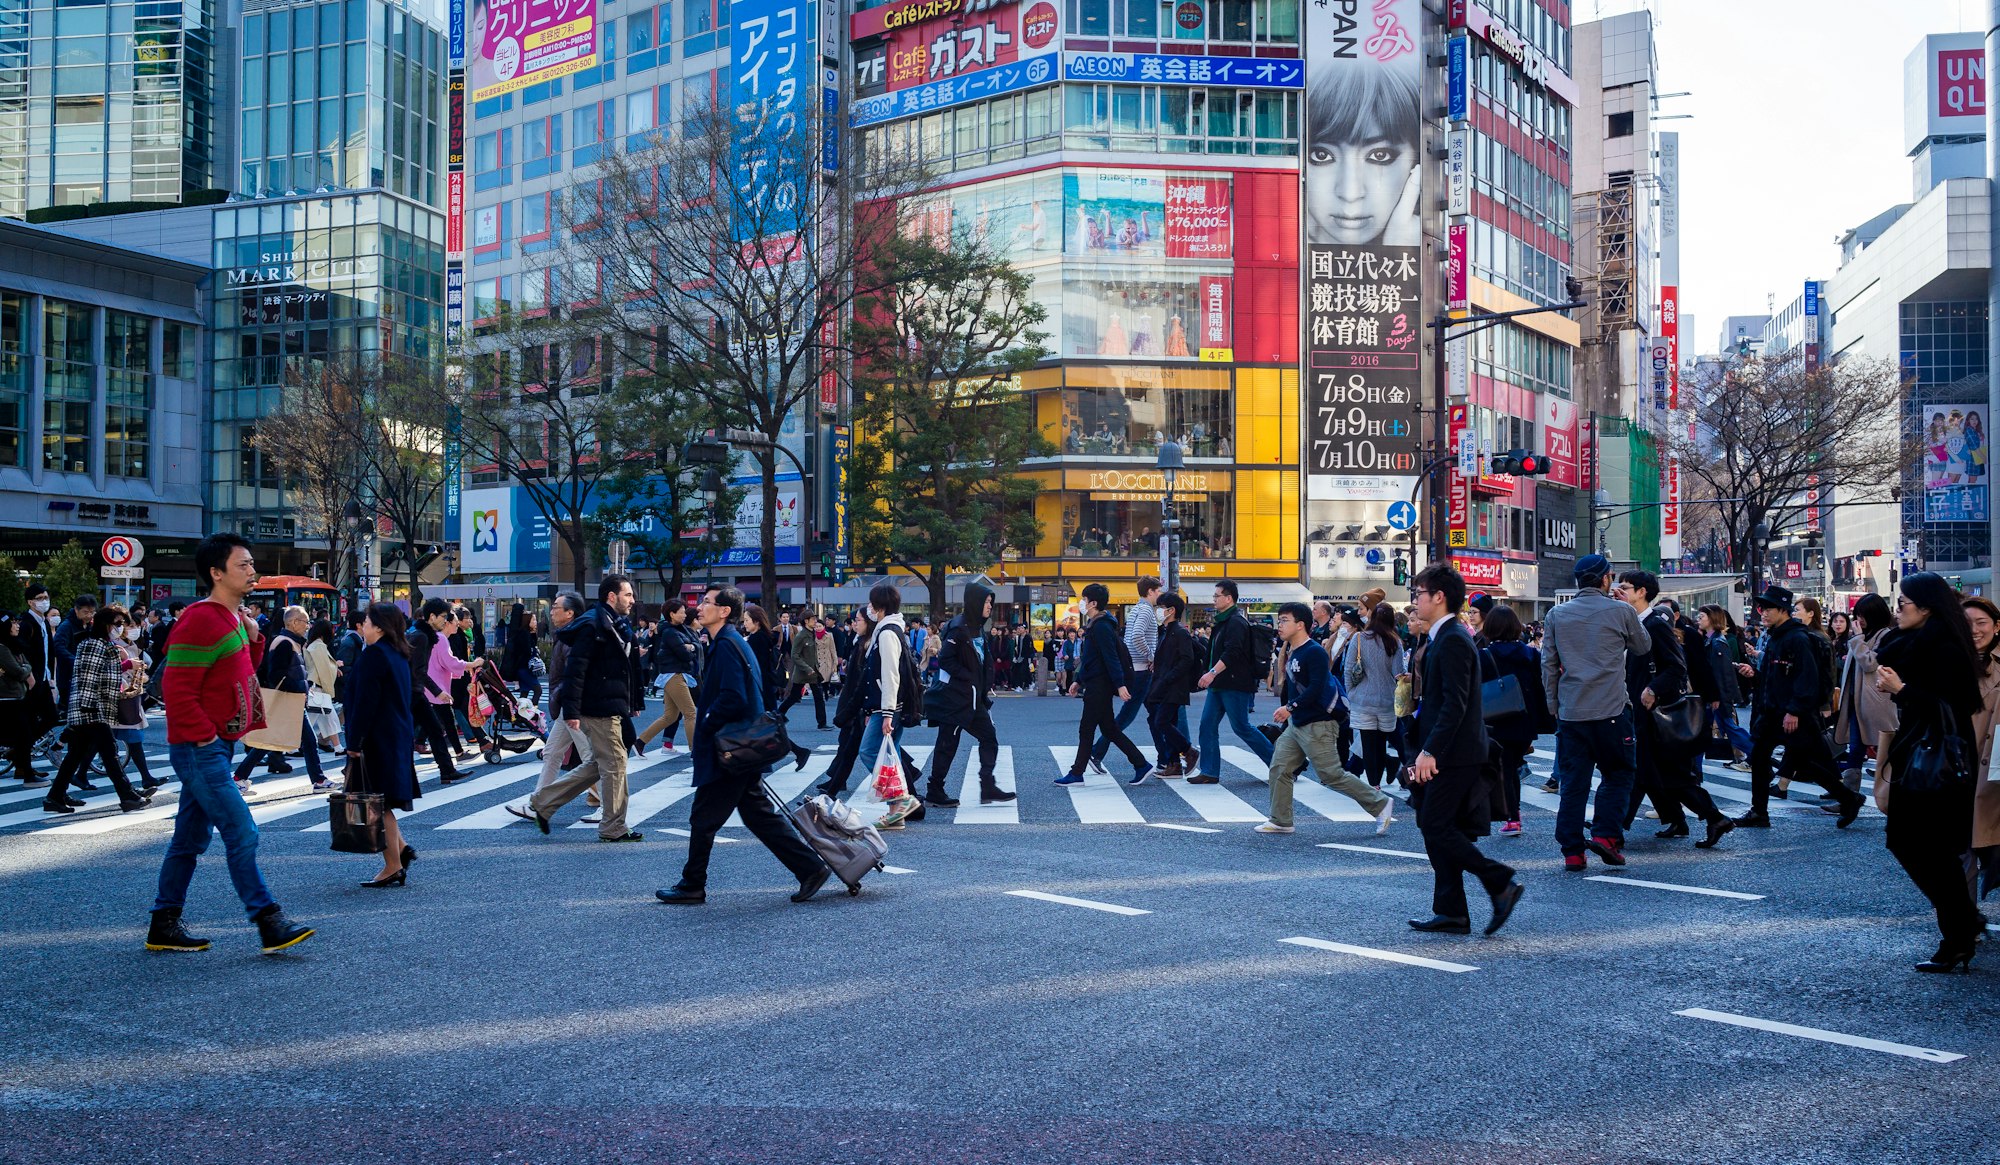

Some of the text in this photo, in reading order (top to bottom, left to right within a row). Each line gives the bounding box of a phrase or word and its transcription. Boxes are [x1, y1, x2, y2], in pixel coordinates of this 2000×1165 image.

[1026, 20, 1055, 38] ガスト
[1180, 14, 1201, 22] ガスト
[893, 44, 926, 70] Café
[930, 23, 1011, 78] ガスト
[500, 61, 514, 76] 4F
[858, 55, 886, 86] 7F
[1028, 61, 1048, 77] 6F
[1073, 57, 1299, 83] AEON 英会話イーオン
[1946, 58, 1984, 81] UN
[903, 69, 1021, 112] 英会話イーオン
[1947, 85, 1984, 112] QL
[451, 95, 462, 150] アメリカン
[450, 155, 462, 163] 8F
[1453, 138, 1463, 208] 渋谷駅前ビル
[452, 174, 462, 215] 外貨両替
[1166, 185, 1206, 204] 沖縄
[1166, 206, 1228, 214] フォトウェディング
[1450, 226, 1466, 236] 5F
[262, 250, 330, 263] SHIBUYA
[1311, 250, 1418, 281] 国立代々木
[226, 260, 370, 284] MARK CITY
[264, 292, 326, 306] 渋谷 マークシティ
[1311, 283, 1418, 314] 競技場第一
[1664, 298, 1676, 324] 免税
[1208, 284, 1224, 342] 毎日開催
[1391, 313, 1408, 336] 3
[1311, 316, 1380, 346] 体育館
[1386, 328, 1416, 350] Days!
[1350, 355, 1380, 366] 2016
[1318, 374, 1411, 404] 7月8日(金)
[1318, 407, 1411, 437] 7月9日(土)
[1314, 440, 1416, 470] 7月10日(日)
[1466, 432, 1475, 472] 渋谷駅前
[1551, 432, 1572, 458] アコム
[1090, 470, 1207, 490] L'OCCITANE
[1452, 530, 1465, 544] 薬
[1544, 518, 1576, 548] LUSH
